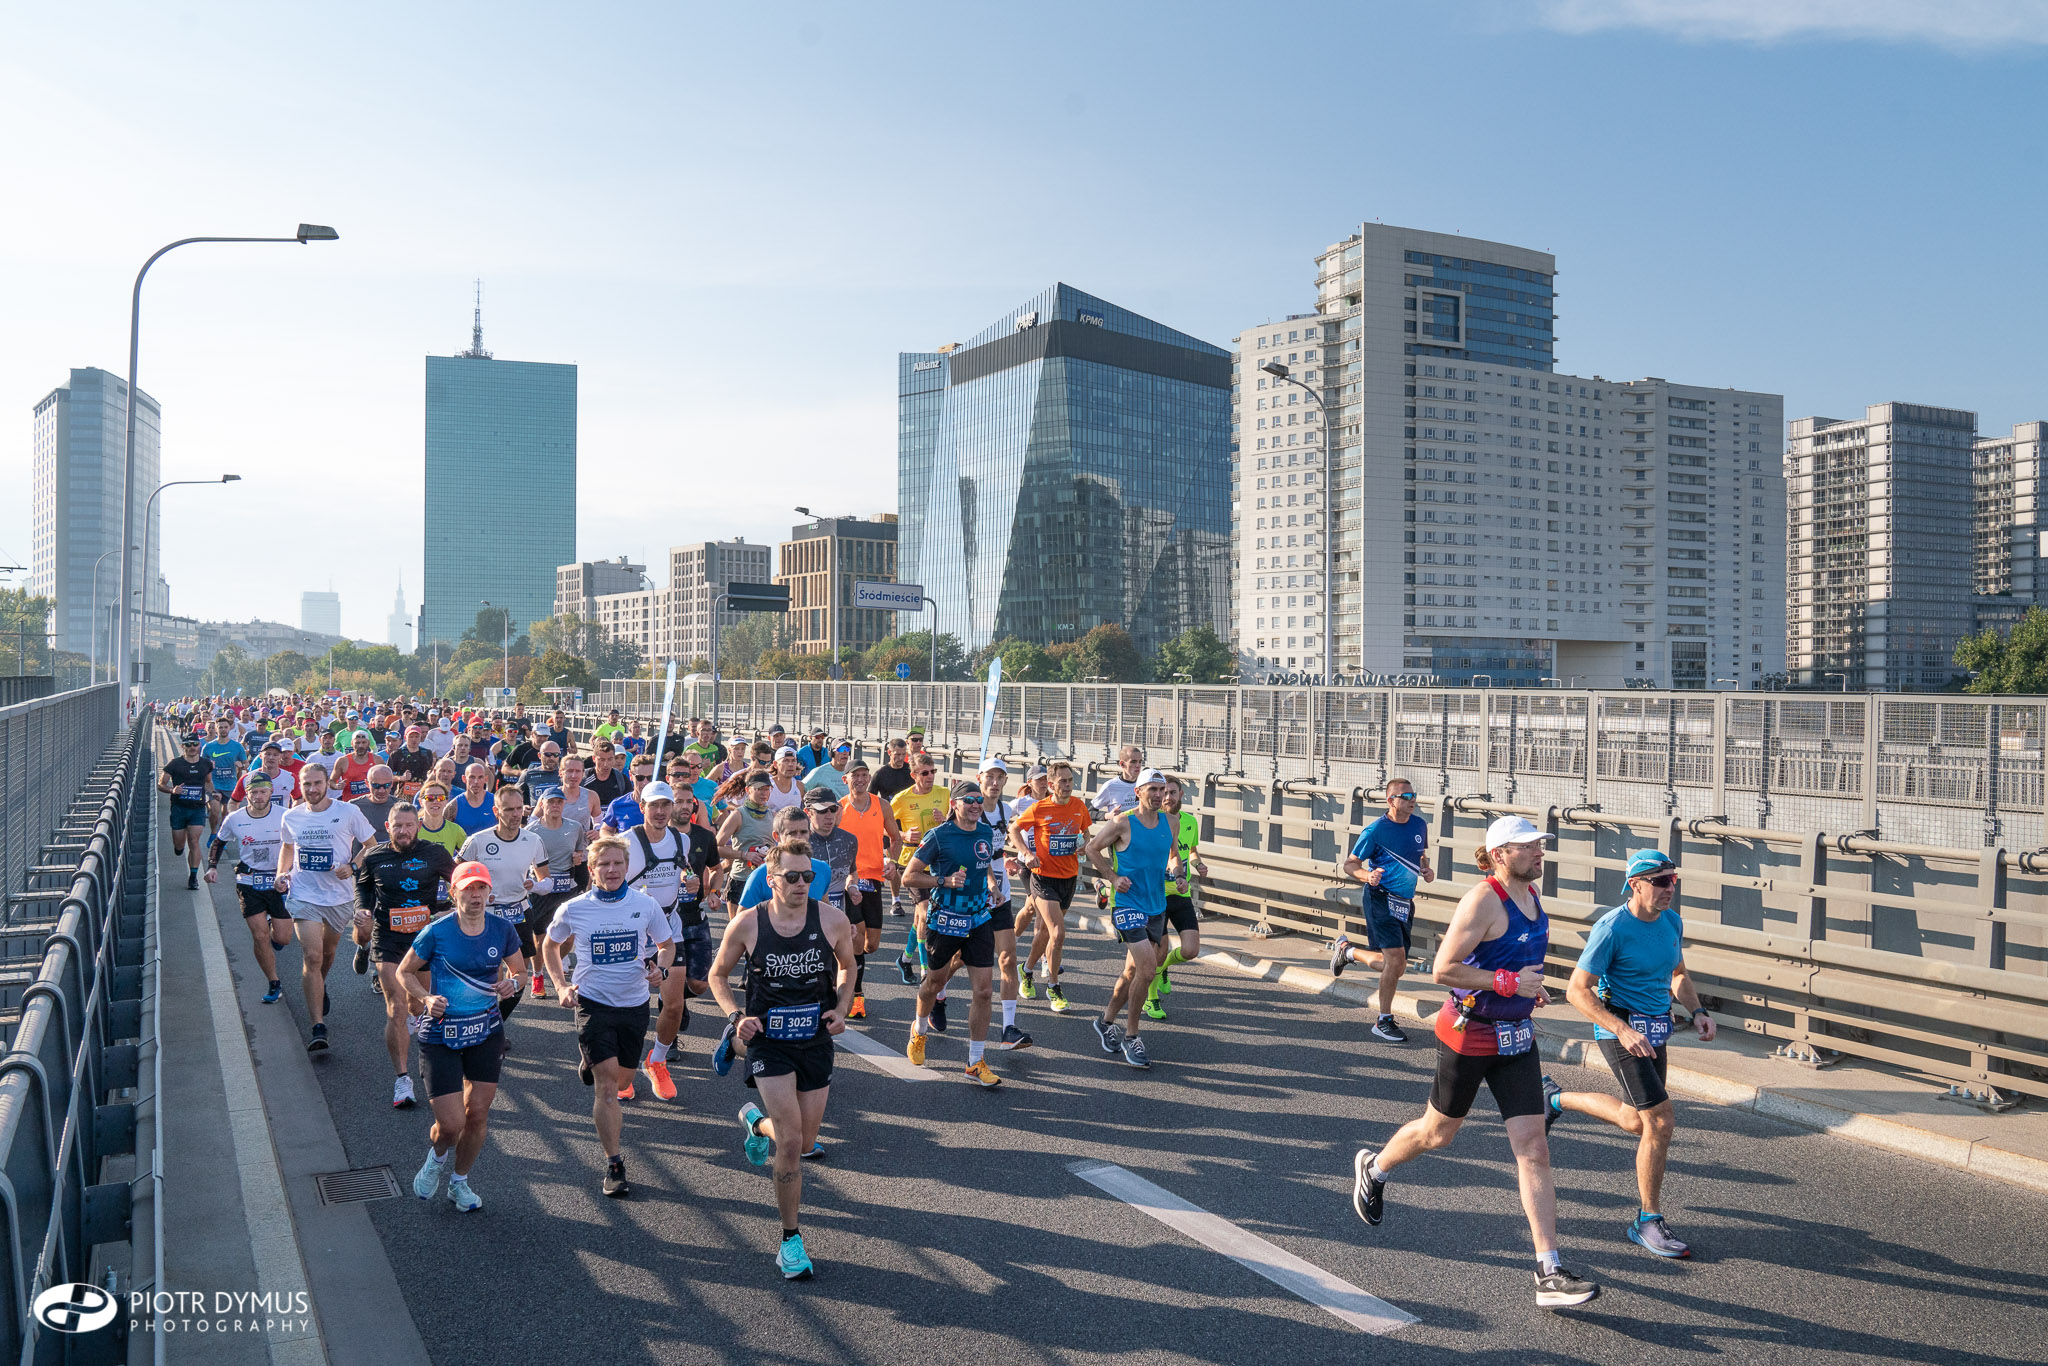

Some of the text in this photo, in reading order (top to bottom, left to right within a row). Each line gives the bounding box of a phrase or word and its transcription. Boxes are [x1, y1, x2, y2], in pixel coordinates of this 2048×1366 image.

[1080, 313, 1104, 327] KPMG
[913, 360, 941, 372] Allianz
[859, 586, 920, 603] Śródmieście
[310, 855, 328, 863] 3234
[557, 878, 571, 886] 2028
[403, 914, 426, 925] 13030
[1128, 913, 1145, 921] 2240
[949, 918, 967, 928] 6265
[1517, 932, 1529, 943] 4F
[609, 941, 632, 952] 3028
[765, 948, 821, 967] Swords
[787, 1016, 812, 1028] 3025
[462, 1022, 484, 1036] 2057
[1514, 1027, 1531, 1043] 3278
